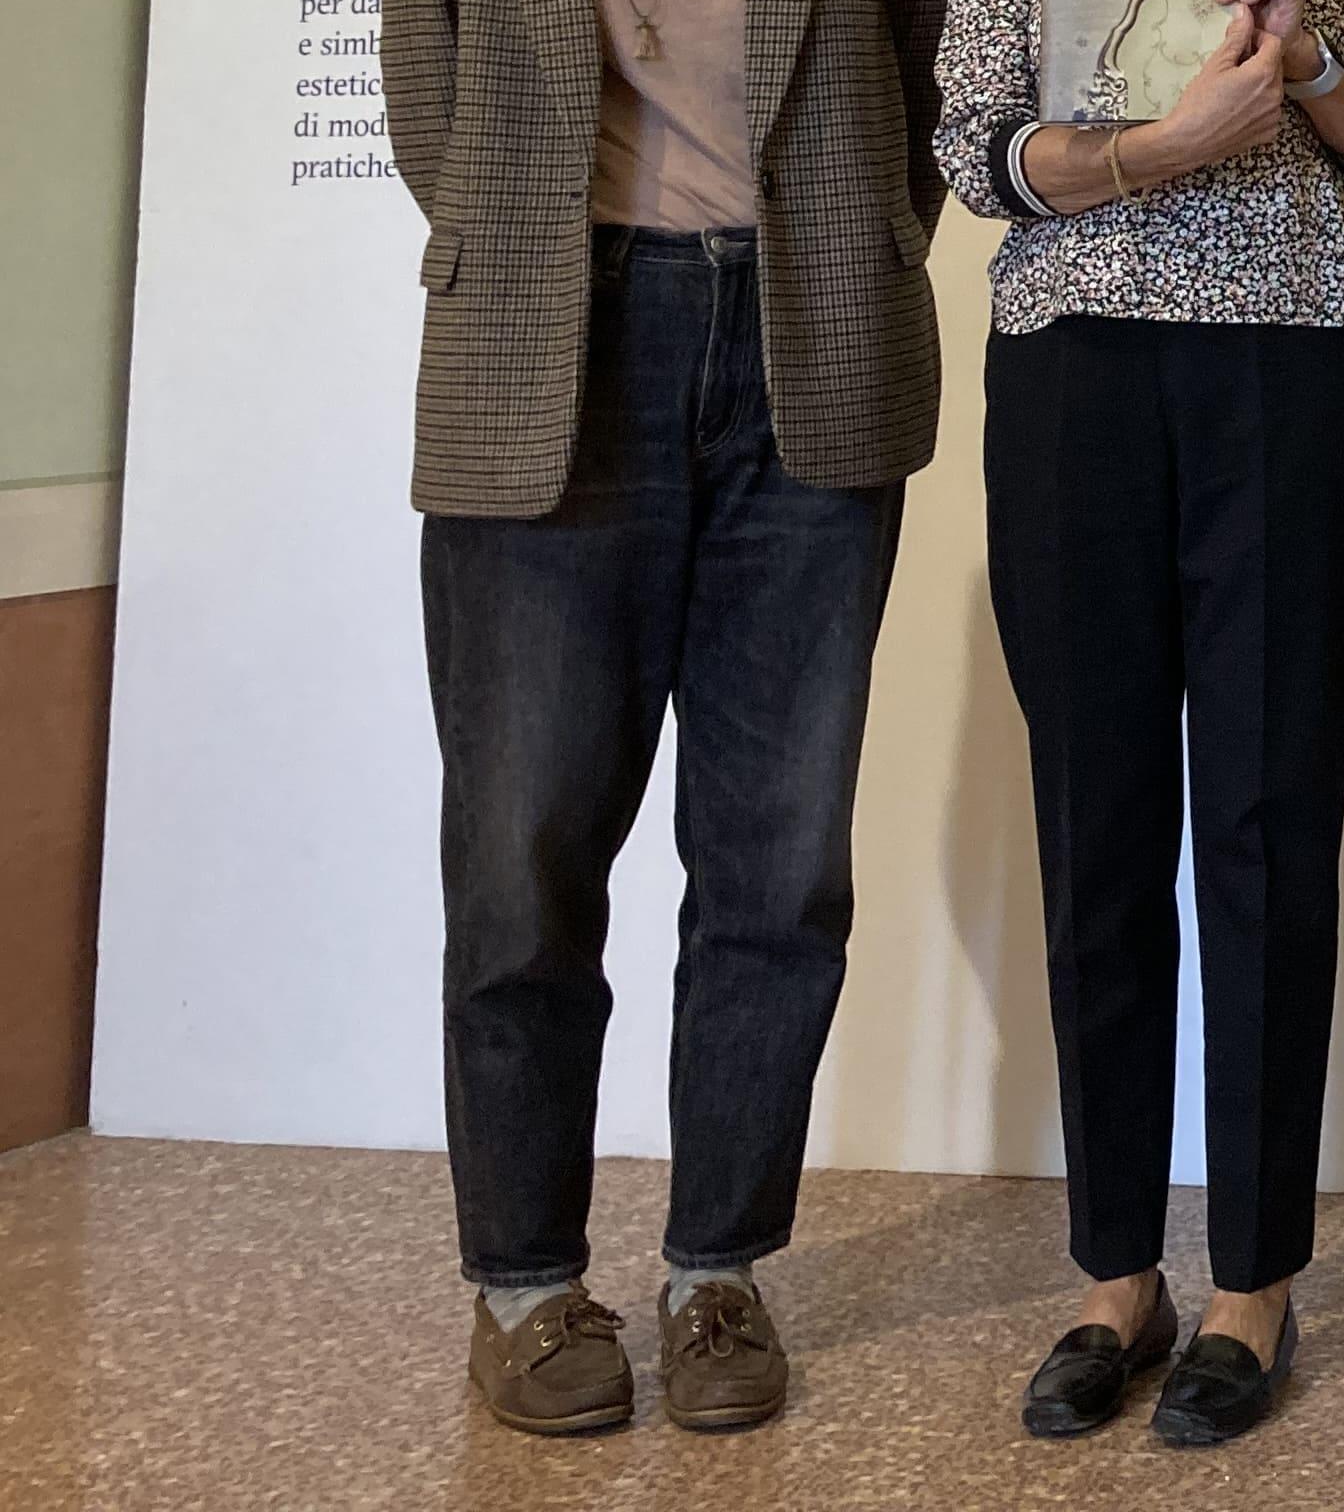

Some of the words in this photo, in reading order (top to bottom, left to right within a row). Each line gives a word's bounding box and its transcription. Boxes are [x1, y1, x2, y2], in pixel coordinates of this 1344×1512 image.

[298, 36, 312, 56] e
[296, 71, 381, 97] estetic
[294, 112, 319, 137] di
[328, 112, 386, 137] mod
[291, 153, 397, 186] pratiche
